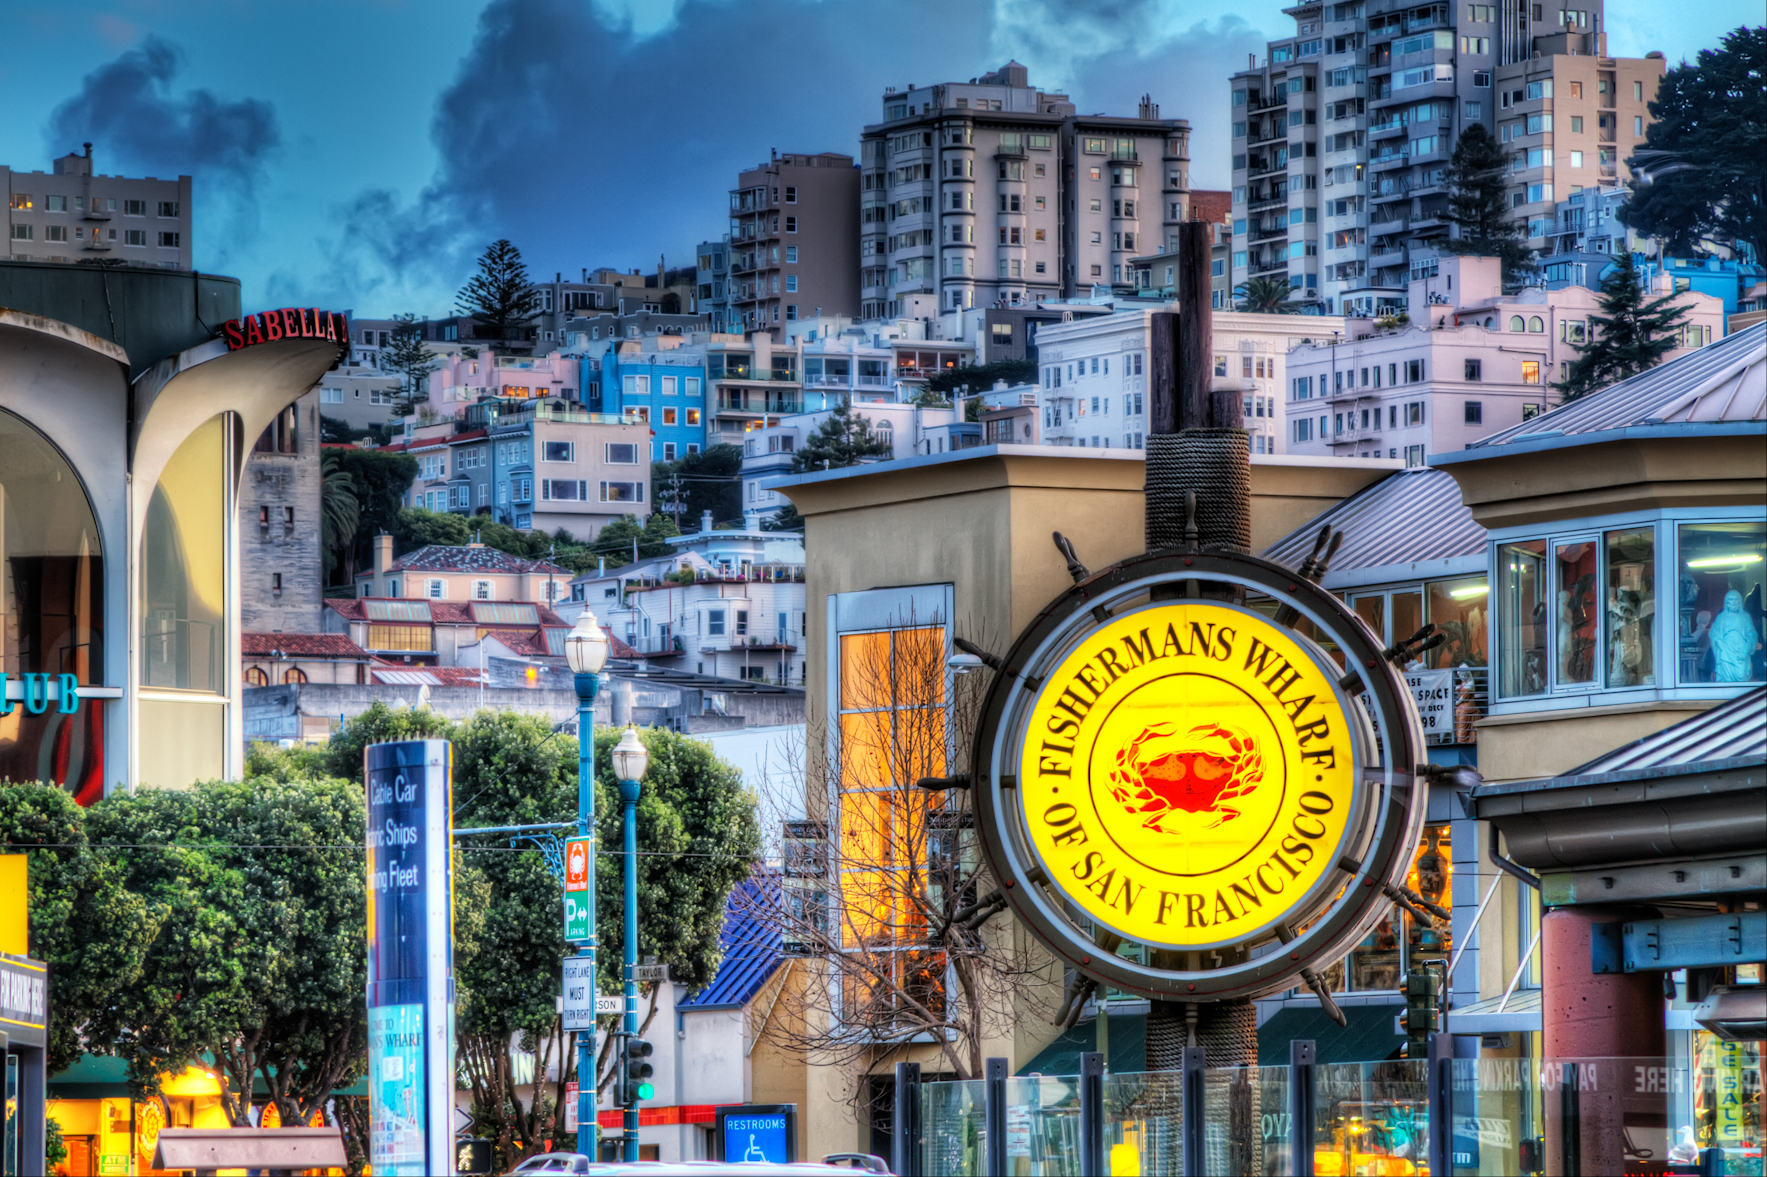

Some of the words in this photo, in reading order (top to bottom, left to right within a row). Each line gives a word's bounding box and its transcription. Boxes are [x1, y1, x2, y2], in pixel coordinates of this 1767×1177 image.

[223, 307, 338, 350] SABELLA
[1038, 622, 1236, 779] FISHERMANS
[1243, 636, 1337, 772] WHARF
[1418, 688, 1448, 701] SPACE
[370, 778, 392, 806] Cable
[394, 774, 418, 803] Car
[386, 818, 418, 849] Ships
[1044, 802, 1088, 848] OF
[1070, 850, 1146, 917] SAN
[1154, 790, 1334, 929] FRANCISCO
[389, 860, 418, 888] Fleet
[565, 967, 577, 978] RIGHT
[578, 966, 590, 978] LANE
[638, 968, 662, 978] TAYLOR
[569, 986, 585, 1000] MUST
[564, 1009, 575, 1020] TURN
[576, 1008, 589, 1020] RIGHT
[385, 1032, 424, 1048] WHARF
[1721, 1076, 1738, 1137] SALE
[727, 1118, 786, 1130] RESTROOMS
[104, 1156, 126, 1164] ATM
